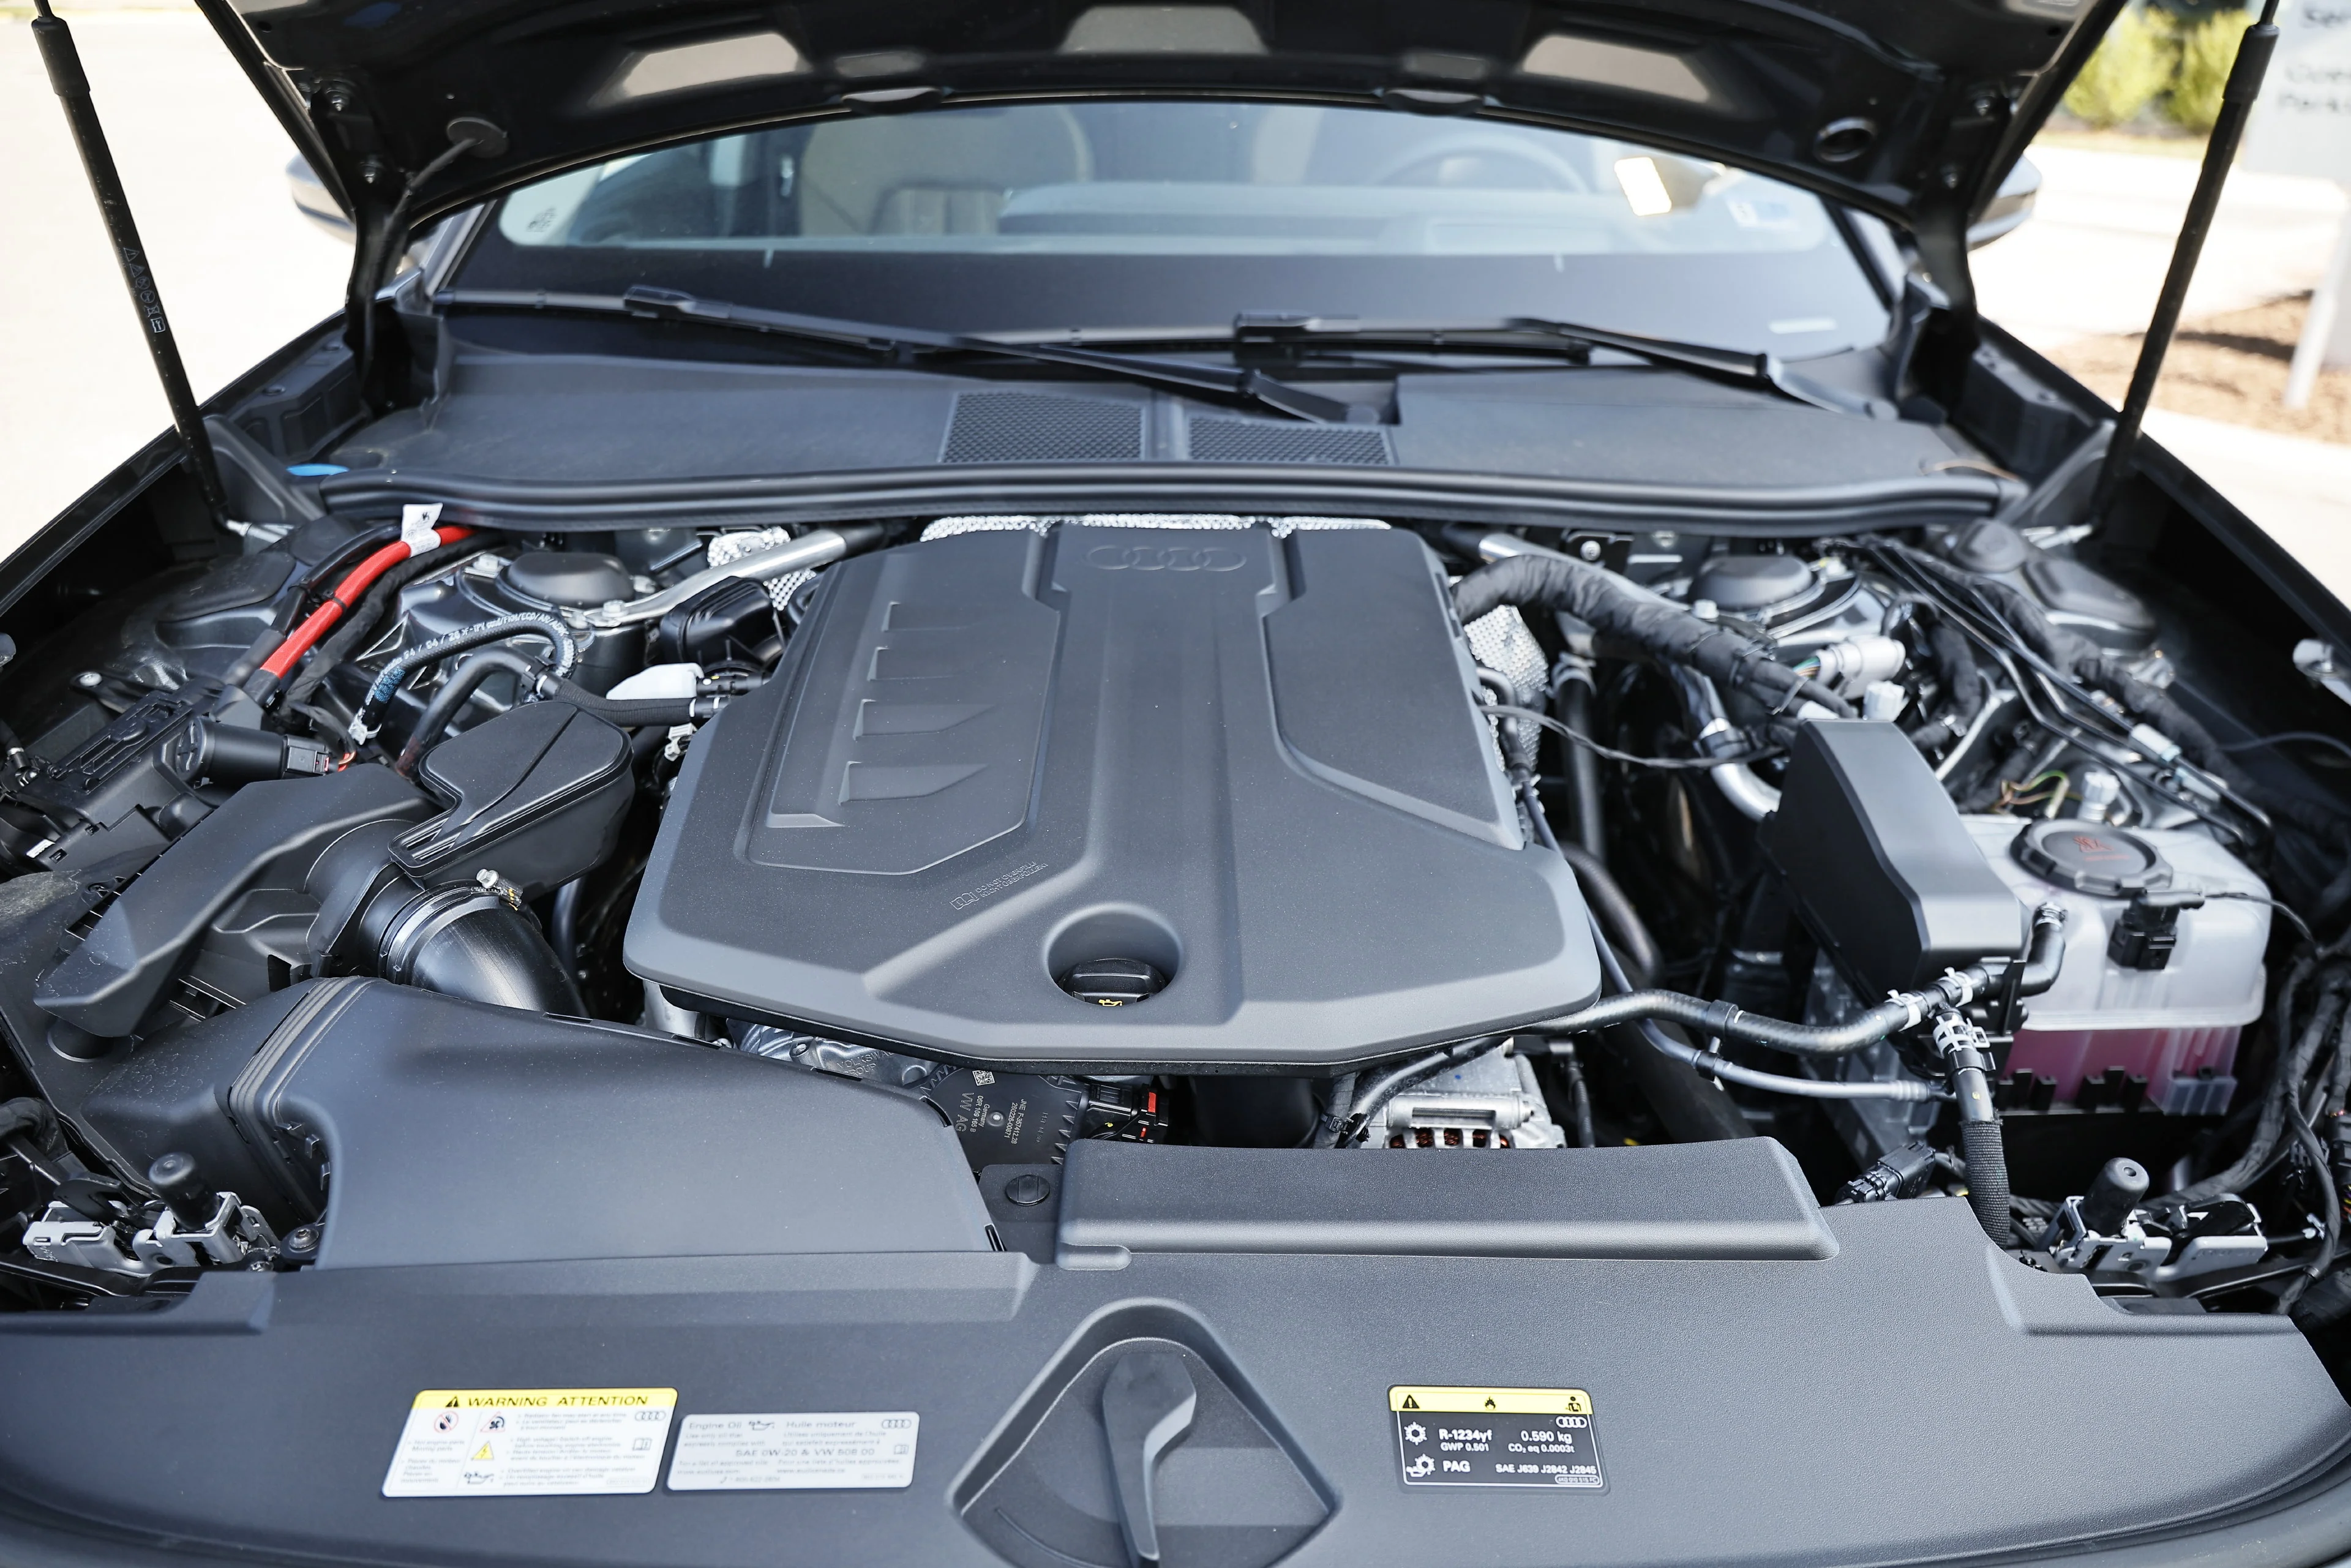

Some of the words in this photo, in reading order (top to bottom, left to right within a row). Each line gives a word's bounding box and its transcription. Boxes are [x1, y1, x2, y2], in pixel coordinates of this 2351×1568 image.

[960, 1092, 974, 1111] VW
[980, 1103, 990, 1127] Germany
[955, 1114, 968, 1131] AG
[468, 1397, 547, 1406] WARNING
[557, 1396, 648, 1406] ATTENTION
[689, 1422, 724, 1430] Engine
[1439, 1428, 1492, 1443] R-1234yf
[1520, 1430, 1554, 1441] 0.590
[1556, 1431, 1572, 1444] kg
[1440, 1442, 1464, 1451] GWP
[1465, 1442, 1489, 1452] 0.501
[1528, 1445, 1540, 1454] eq
[1442, 1460, 1471, 1472] PAG
[1495, 1463, 1515, 1473] SAE
[1517, 1464, 1539, 1473] J639
[1540, 1465, 1568, 1474] J2842
[1569, 1465, 1597, 1474] J2845
